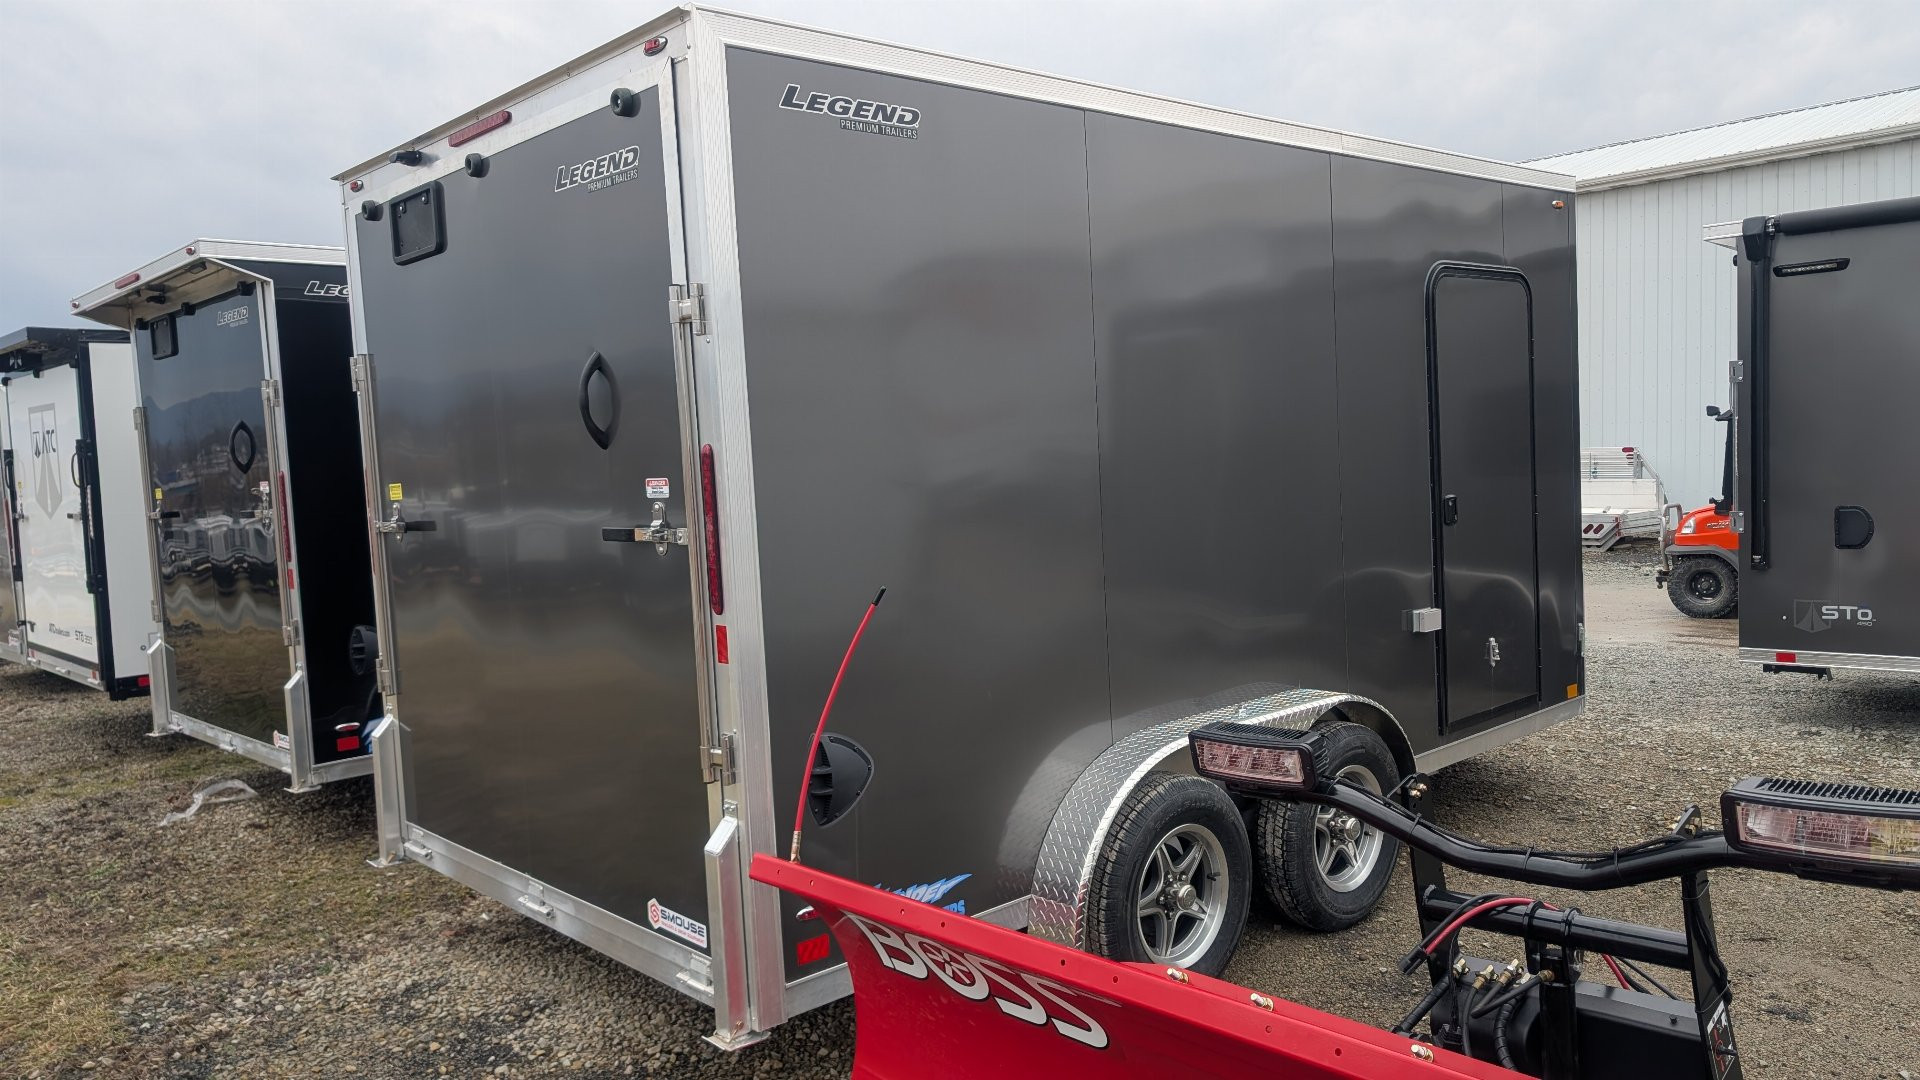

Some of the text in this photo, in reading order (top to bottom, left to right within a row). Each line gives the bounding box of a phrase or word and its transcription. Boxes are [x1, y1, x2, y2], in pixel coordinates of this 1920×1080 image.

[779, 83, 921, 128] LEGEND
[841, 119, 917, 139] PREMIUM TRAILERS
[555, 145, 640, 192] LEGEND
[304, 280, 349, 298] LEG
[217, 305, 249, 326] LEGEND
[42, 429, 56, 454] ATC
[661, 909, 705, 938] SMOUSE
[838, 909, 1109, 1048] BOSS
